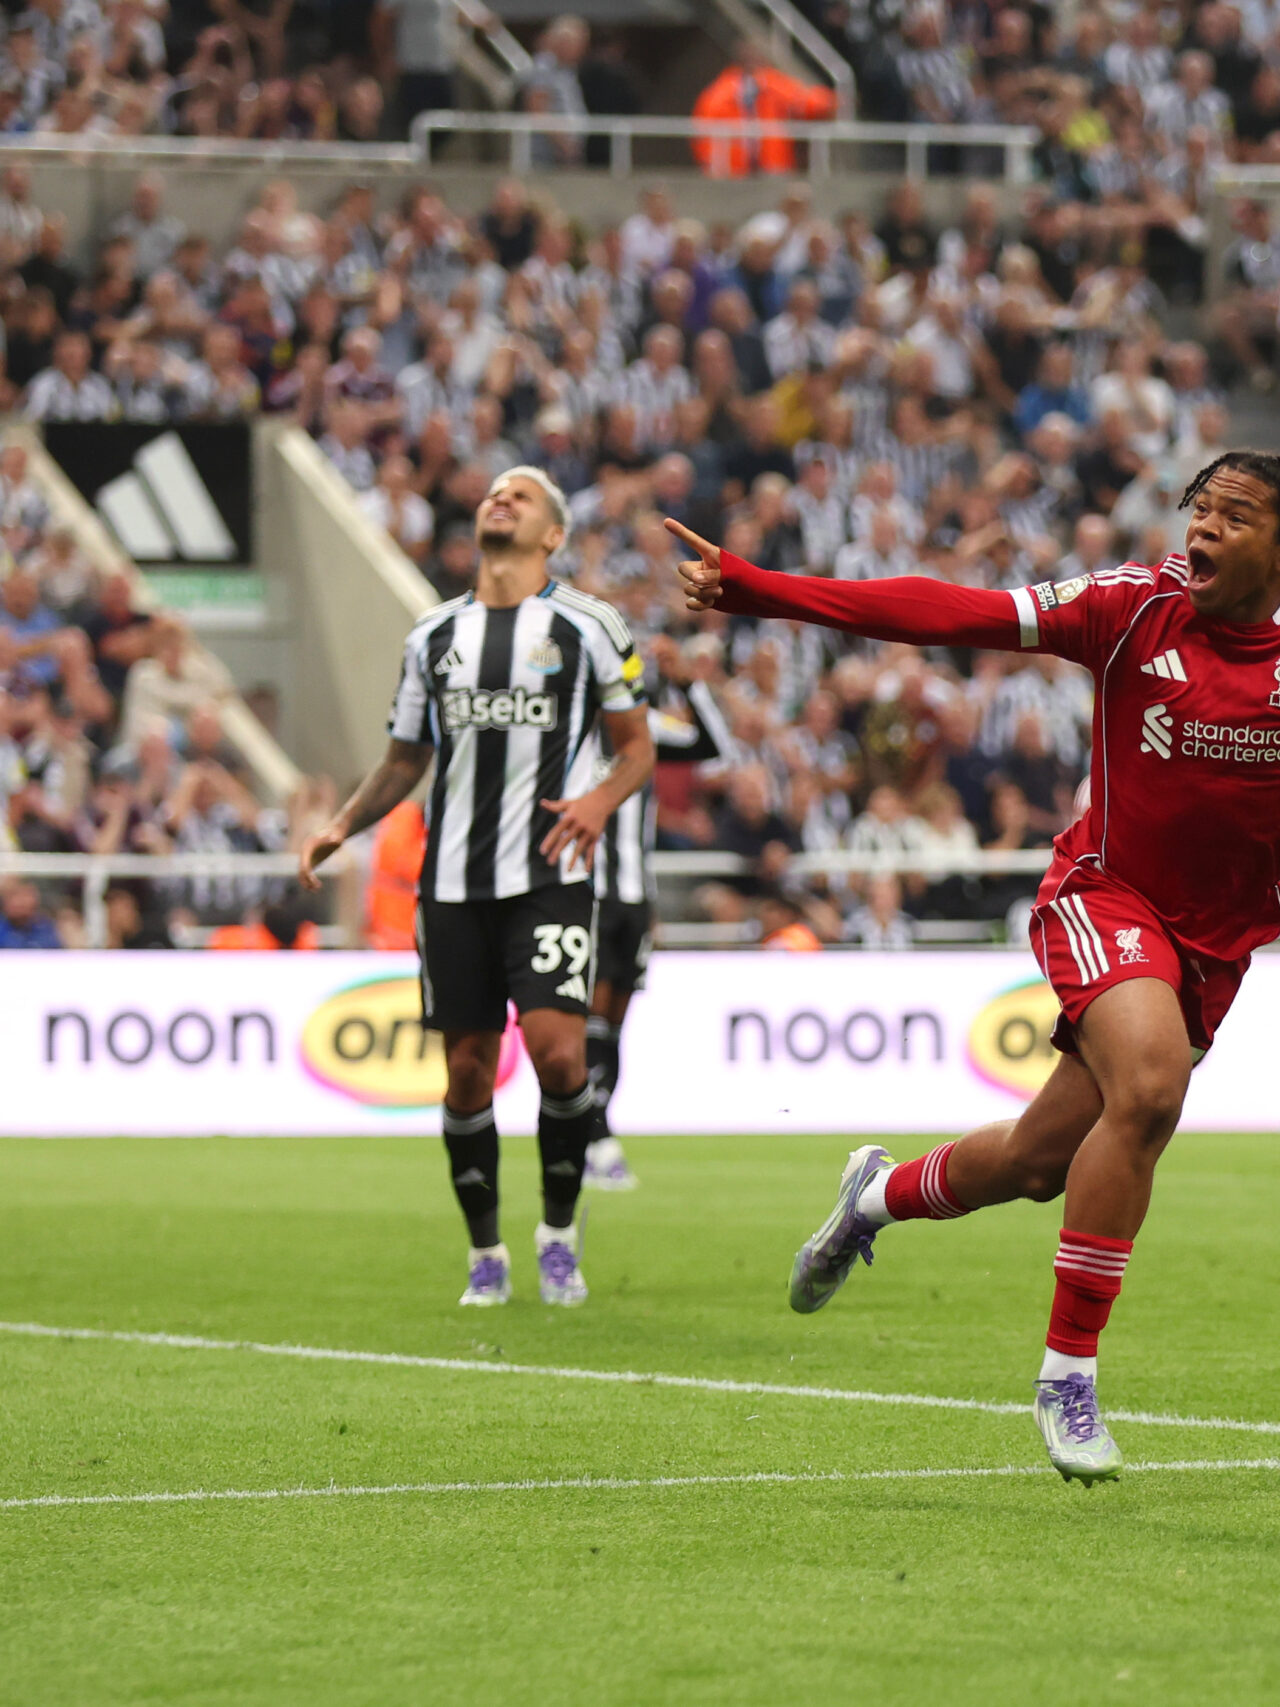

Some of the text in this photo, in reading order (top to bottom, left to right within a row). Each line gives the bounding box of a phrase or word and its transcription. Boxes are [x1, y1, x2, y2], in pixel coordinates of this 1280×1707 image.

[530, 923, 590, 975] 39
[44, 1011, 275, 1064] noon
[727, 1011, 944, 1063] noon
